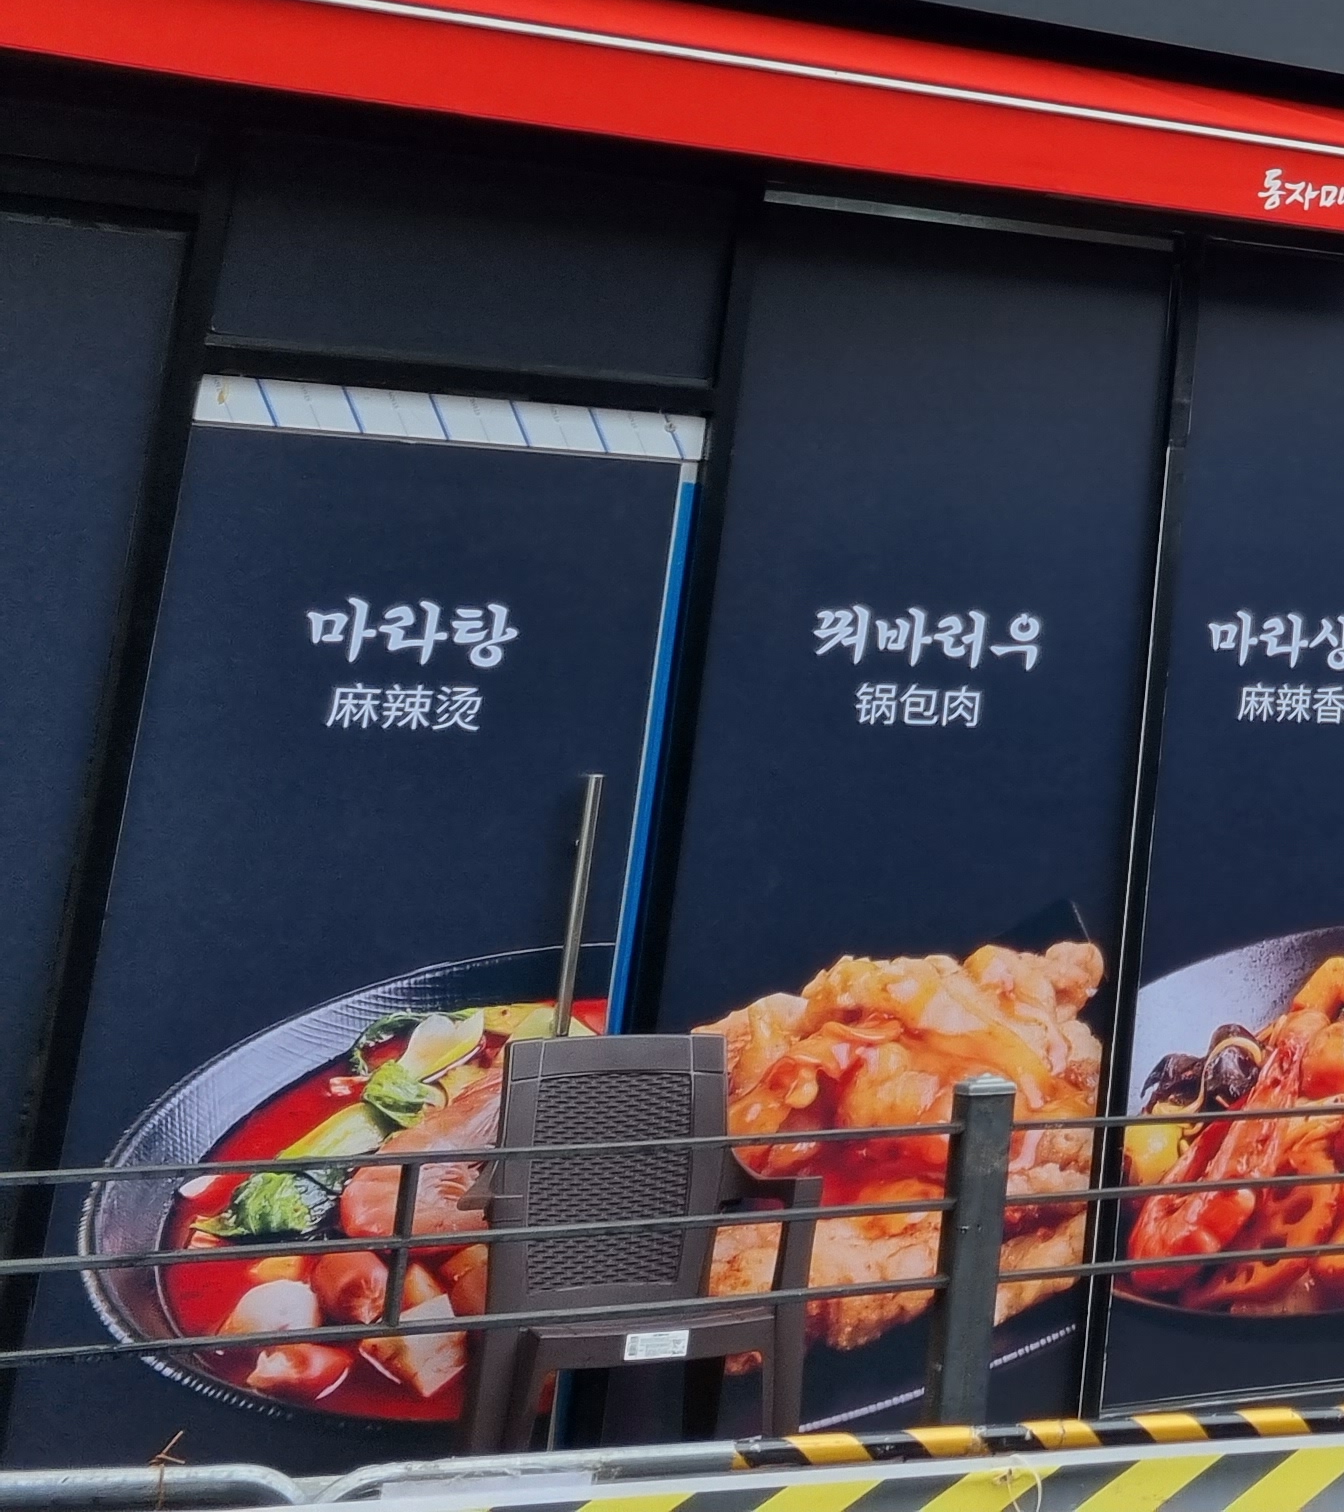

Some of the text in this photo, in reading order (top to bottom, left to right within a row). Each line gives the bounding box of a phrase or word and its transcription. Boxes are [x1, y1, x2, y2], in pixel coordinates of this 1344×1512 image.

[306, 596, 519, 668] 마라탕
[325, 682, 484, 731] 麻辣烫
[854, 682, 983, 728] 锅包肉
